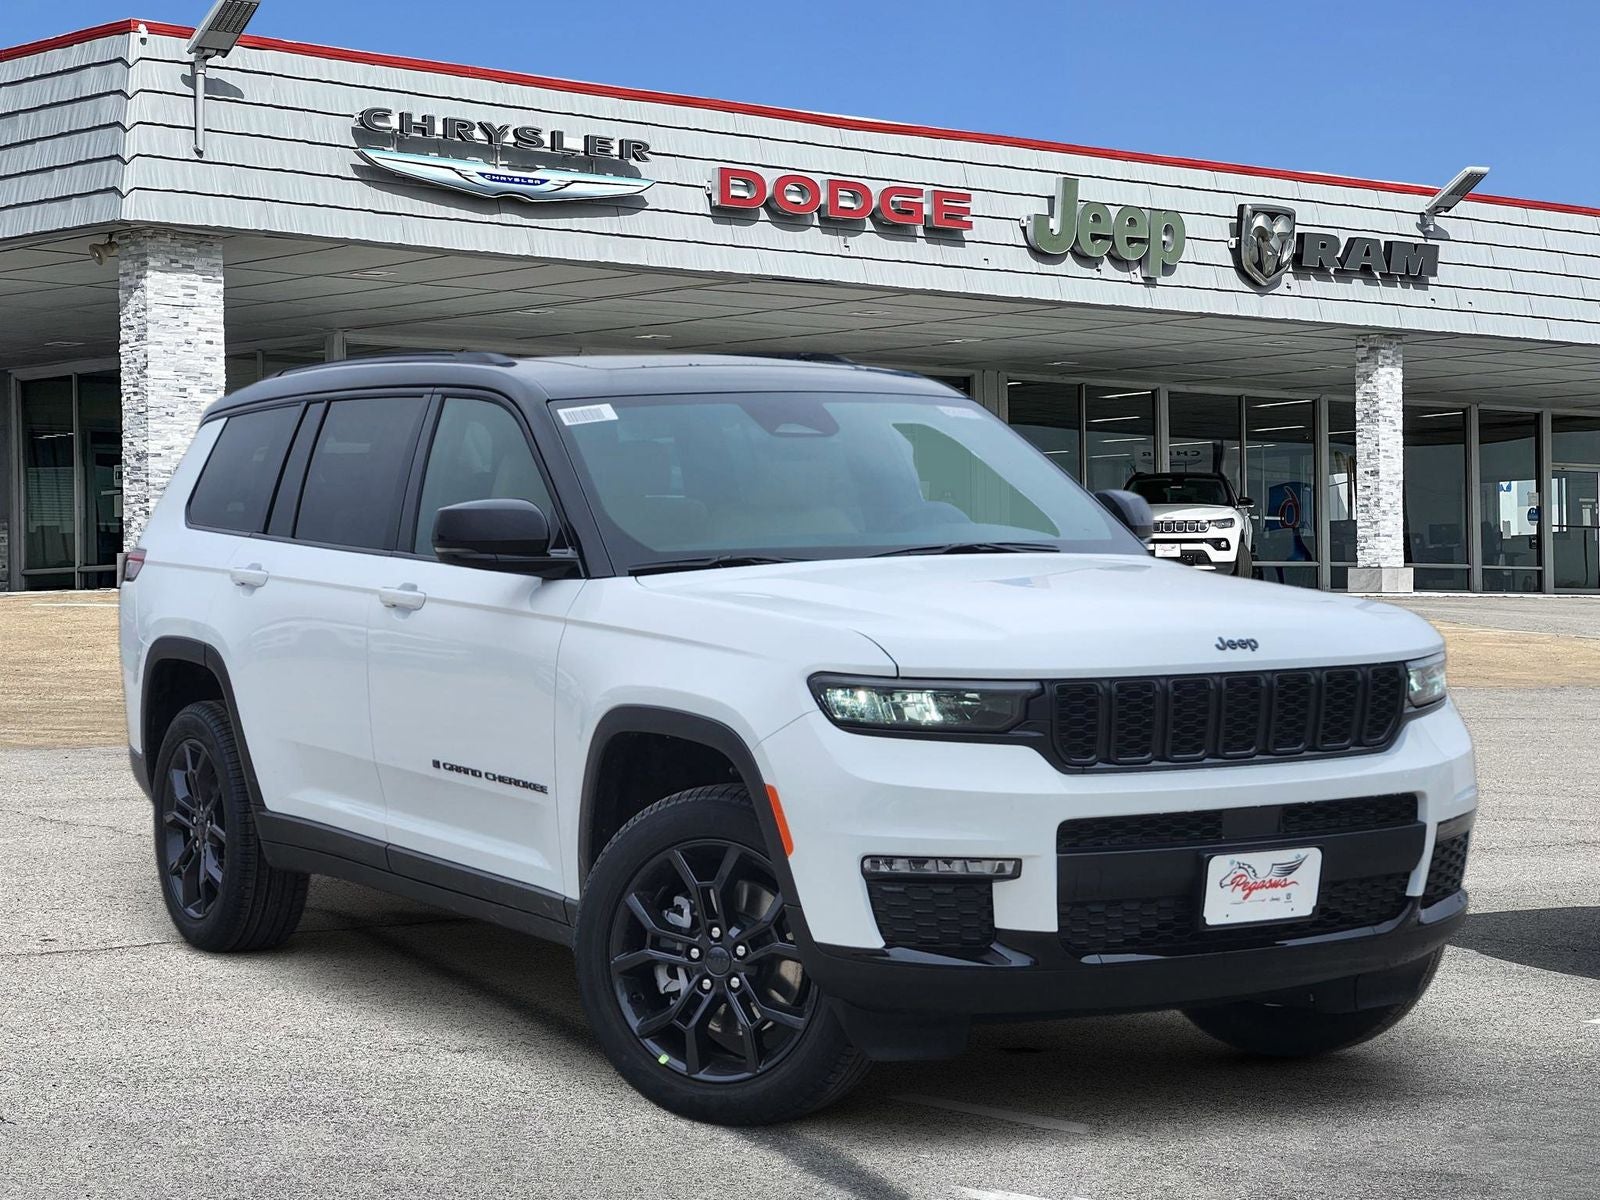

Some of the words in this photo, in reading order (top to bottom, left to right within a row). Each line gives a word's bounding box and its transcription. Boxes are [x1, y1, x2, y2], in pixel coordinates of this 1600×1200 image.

[355, 106, 652, 162] CHRYSLER
[484, 174, 541, 185] CHRYSLER
[711, 166, 974, 231] DODGE
[1025, 177, 1187, 279] Jeep
[1298, 232, 1440, 277] RAM
[1214, 636, 1259, 652] Jeep
[442, 762, 482, 778] GRAND
[484, 772, 548, 795] CHEROKEE
[1230, 873, 1299, 900] Pegasus
